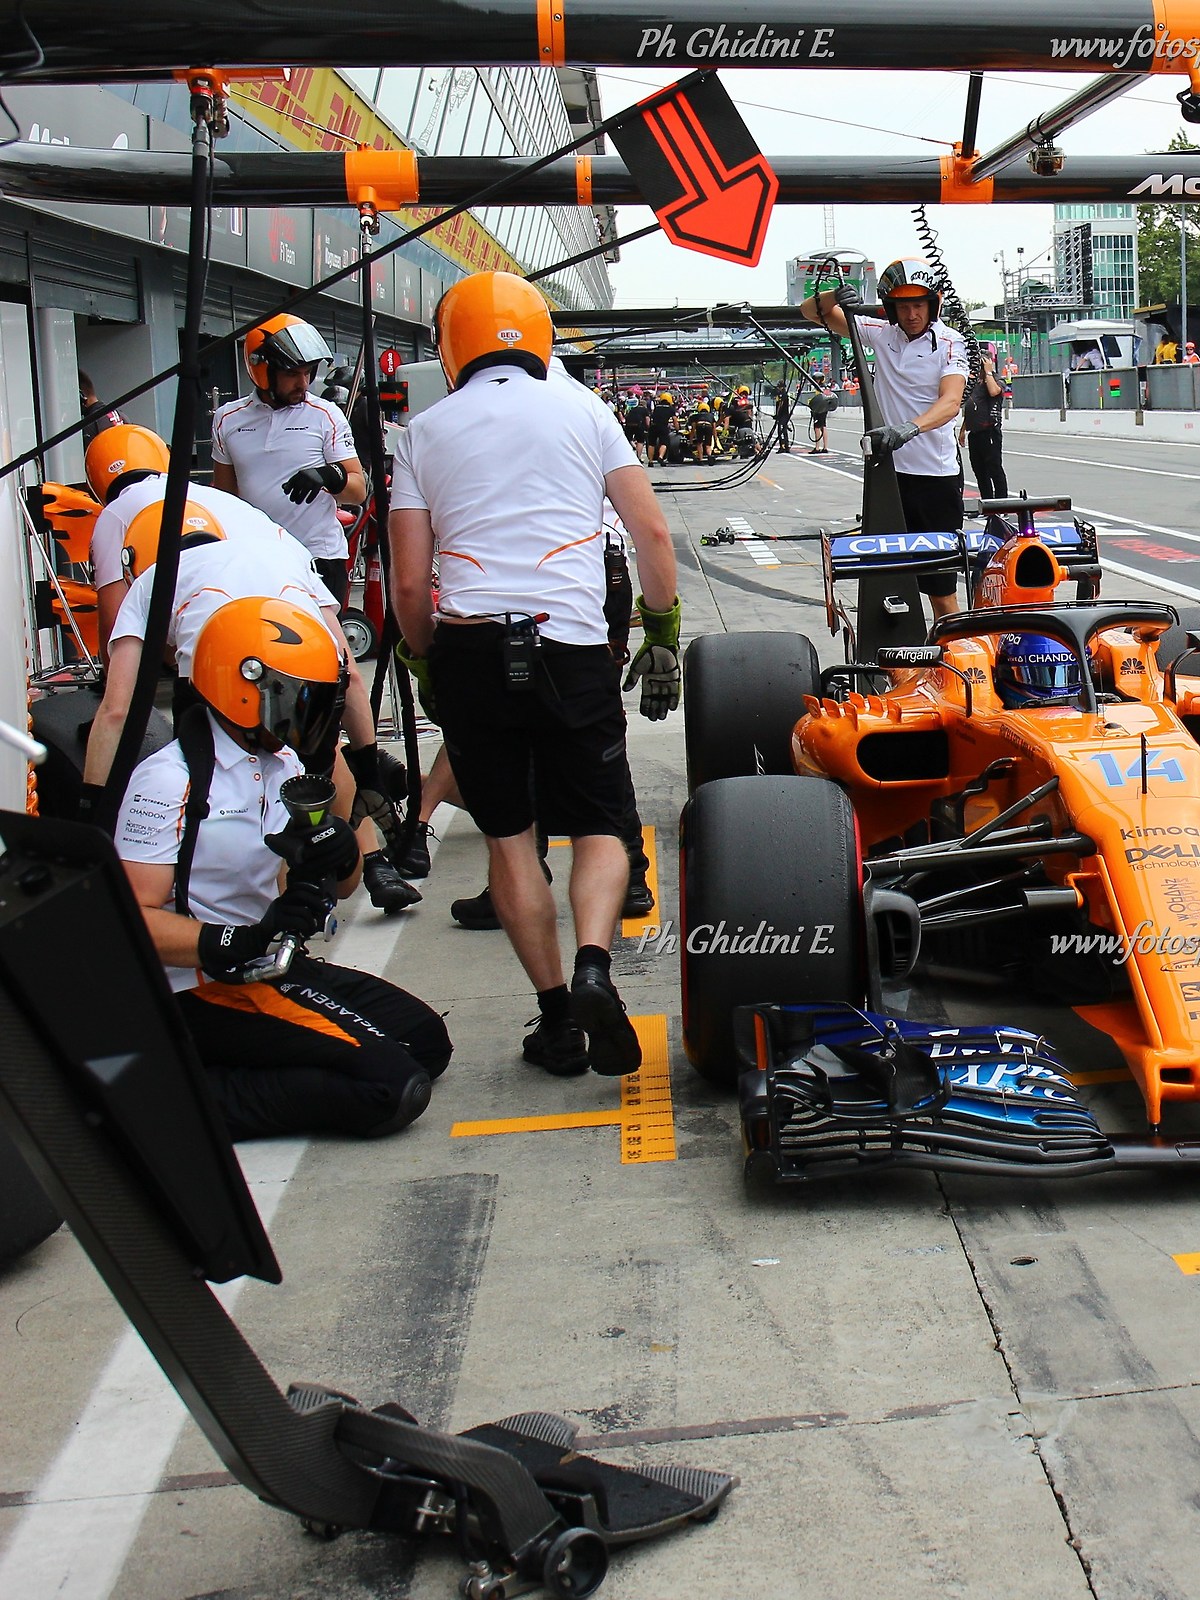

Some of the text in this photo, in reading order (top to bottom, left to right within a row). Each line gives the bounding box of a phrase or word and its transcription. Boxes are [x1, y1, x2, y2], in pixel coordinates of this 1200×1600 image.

[109, 461, 125, 471] BELL
[188, 518, 205, 526] BELL
[895, 650, 933, 663] Airgain
[1028, 653, 1078, 663] CHANDO
[1088, 750, 1186, 788] 14
[129, 807, 166, 820] CHANDON
[311, 827, 336, 844] sparco
[1120, 826, 1200, 840] kimoa
